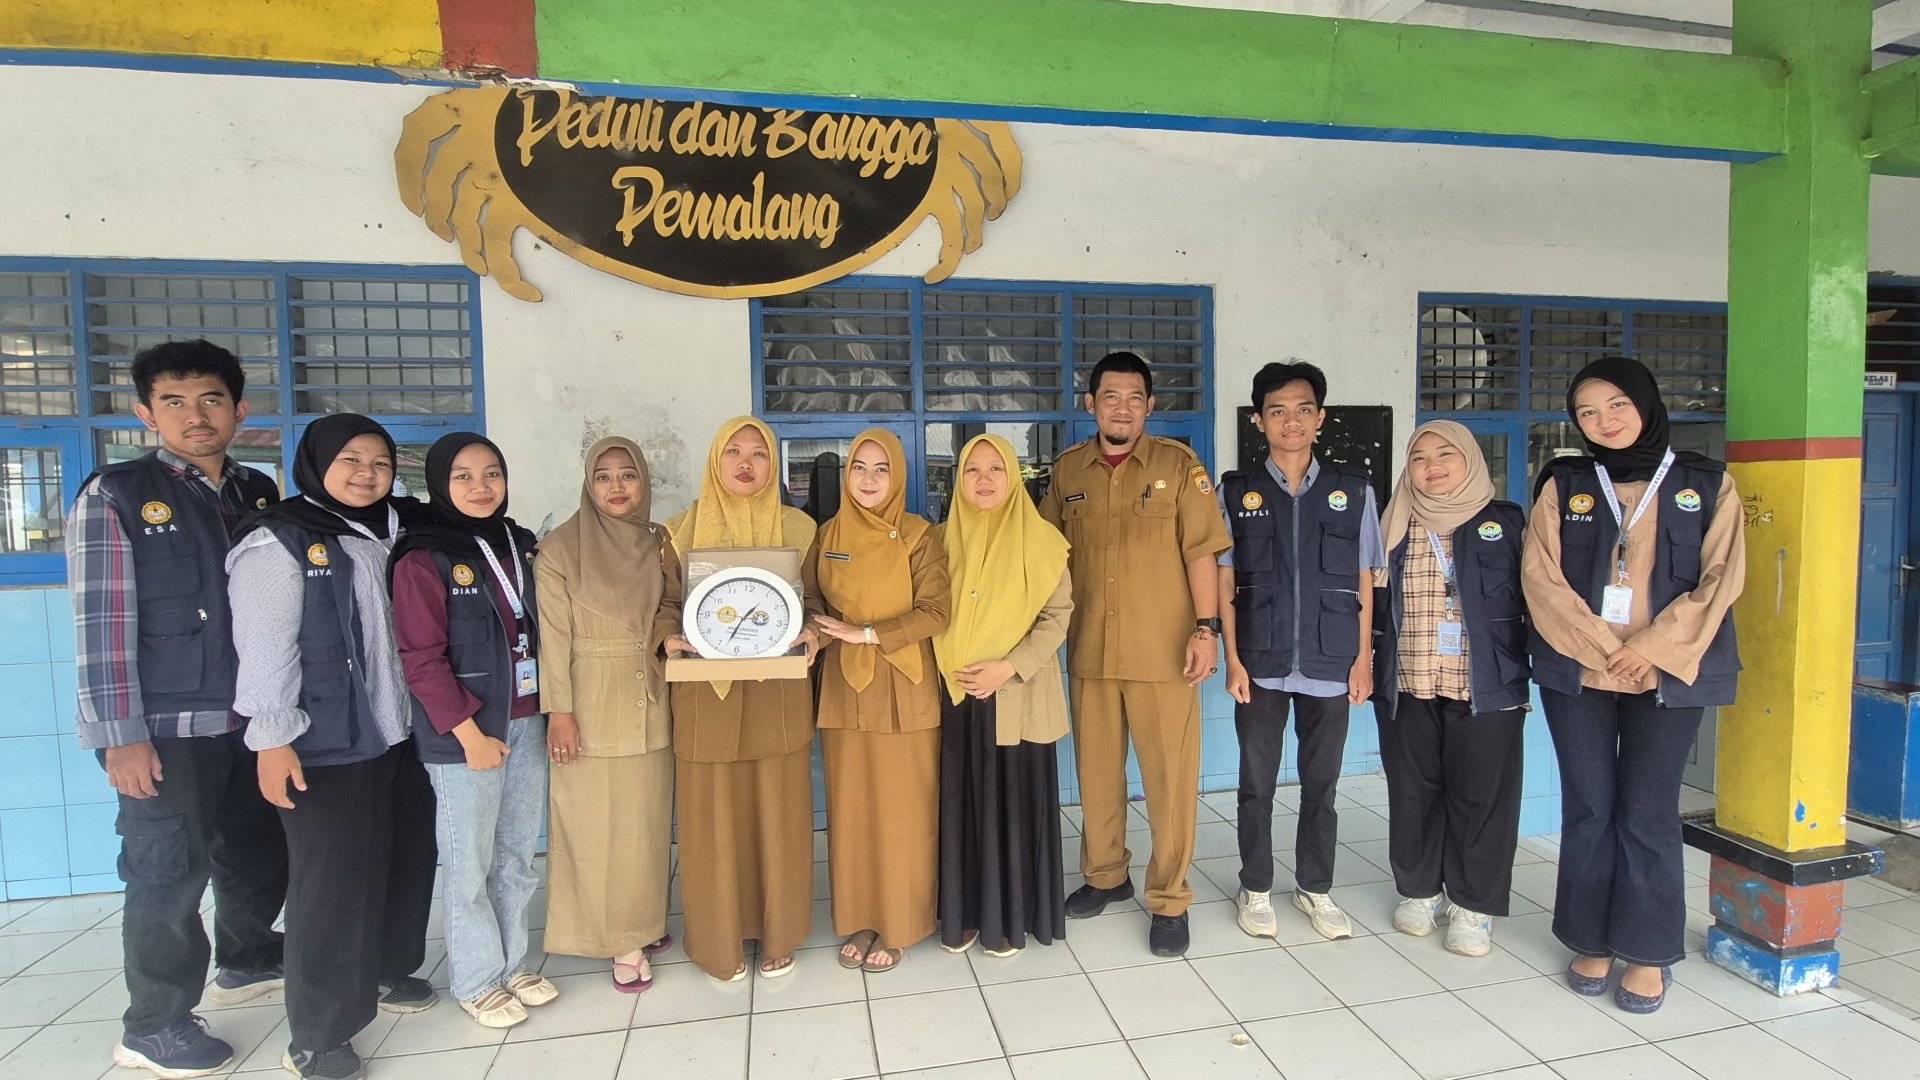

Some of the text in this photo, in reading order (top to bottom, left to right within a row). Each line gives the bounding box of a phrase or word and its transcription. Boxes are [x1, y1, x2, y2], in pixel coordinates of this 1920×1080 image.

[515, 88, 665, 167] Peduli
[669, 101, 757, 158] dan
[611, 165, 839, 249] Pemalang
[1238, 509, 1269, 518] RAFLI
[144, 524, 178, 535] ESA
[307, 568, 332, 577] RIYA
[452, 587, 478, 595] DIAN
[744, 585, 756, 593] 12
[704, 611, 710, 619] 9
[733, 645, 740, 654] 6
